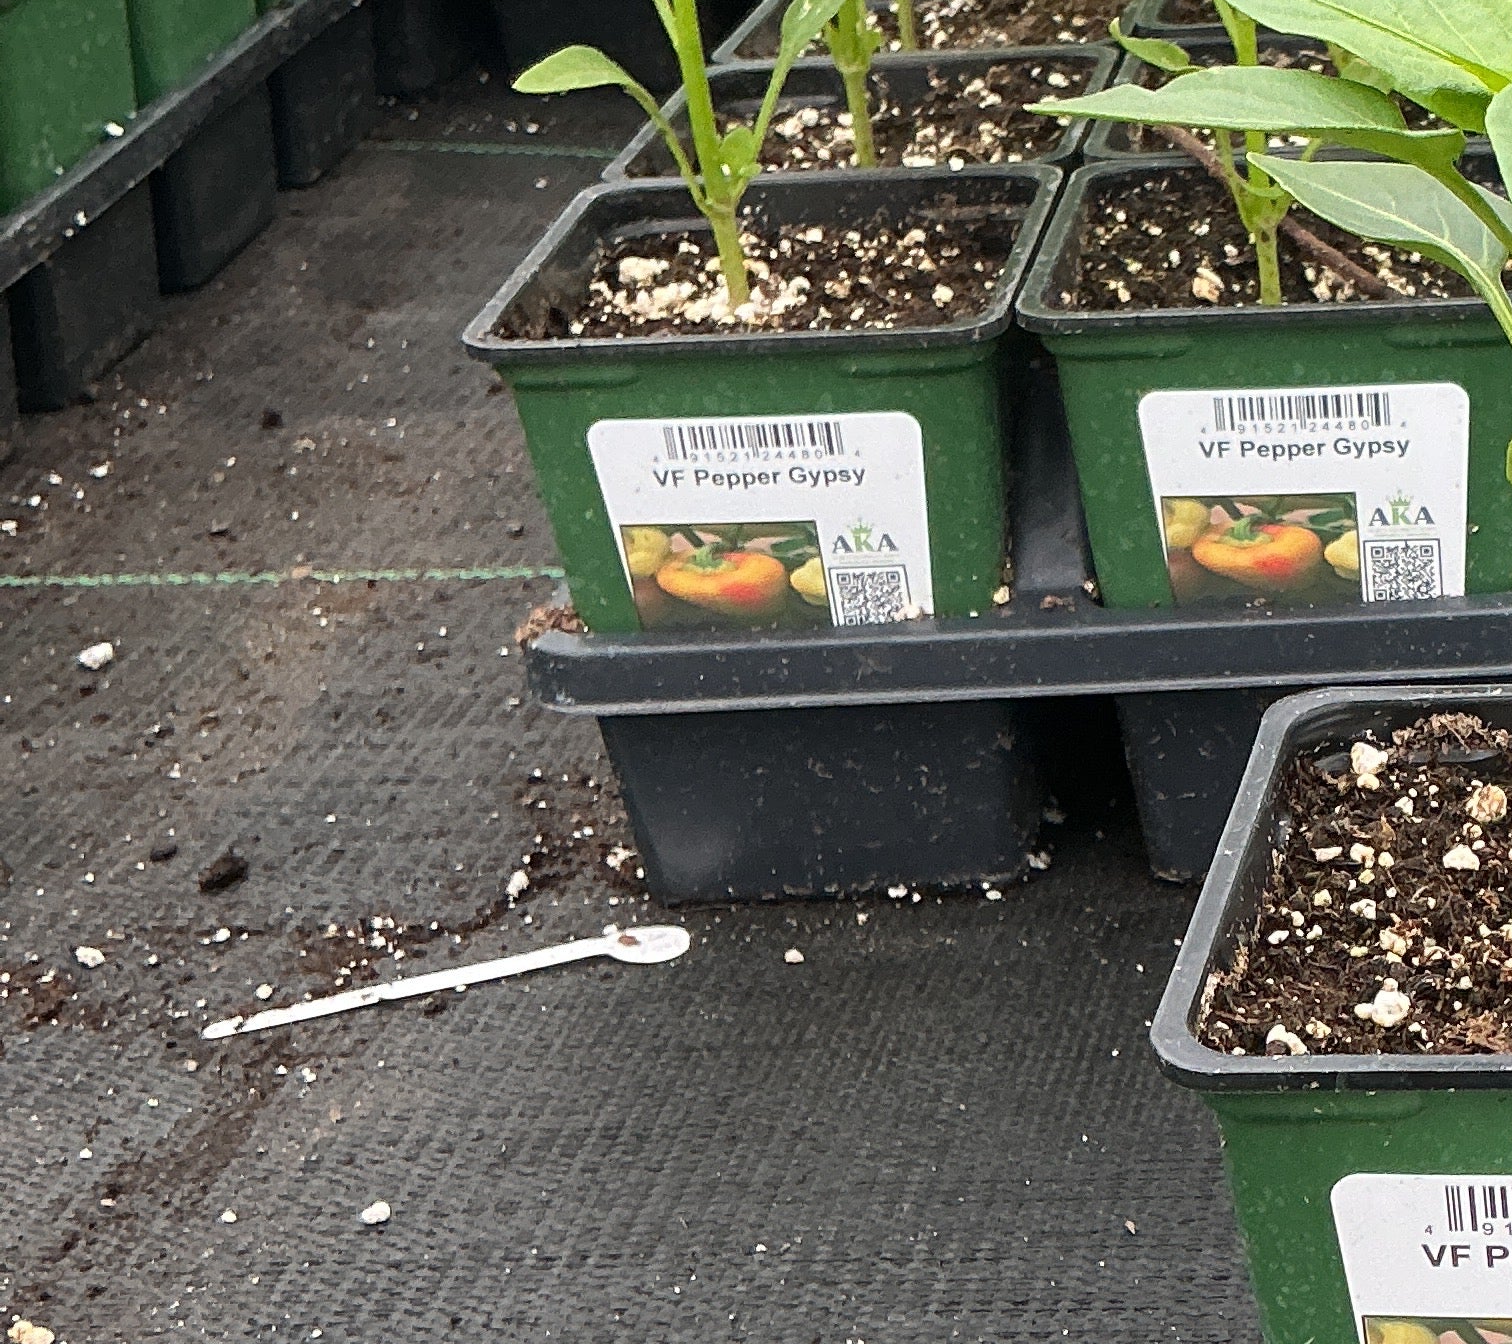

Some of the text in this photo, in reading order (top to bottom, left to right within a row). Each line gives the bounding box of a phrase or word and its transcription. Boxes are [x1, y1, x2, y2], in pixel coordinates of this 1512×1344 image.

[1199, 437, 1410, 461] VF Pepper Gypsy
[652, 466, 866, 490] VF Pepper Gypsy
[1368, 505, 1435, 527] AKA
[832, 533, 898, 554] AKA
[1424, 1224, 1433, 1236] 4
[1421, 1244, 1471, 1268] VF
